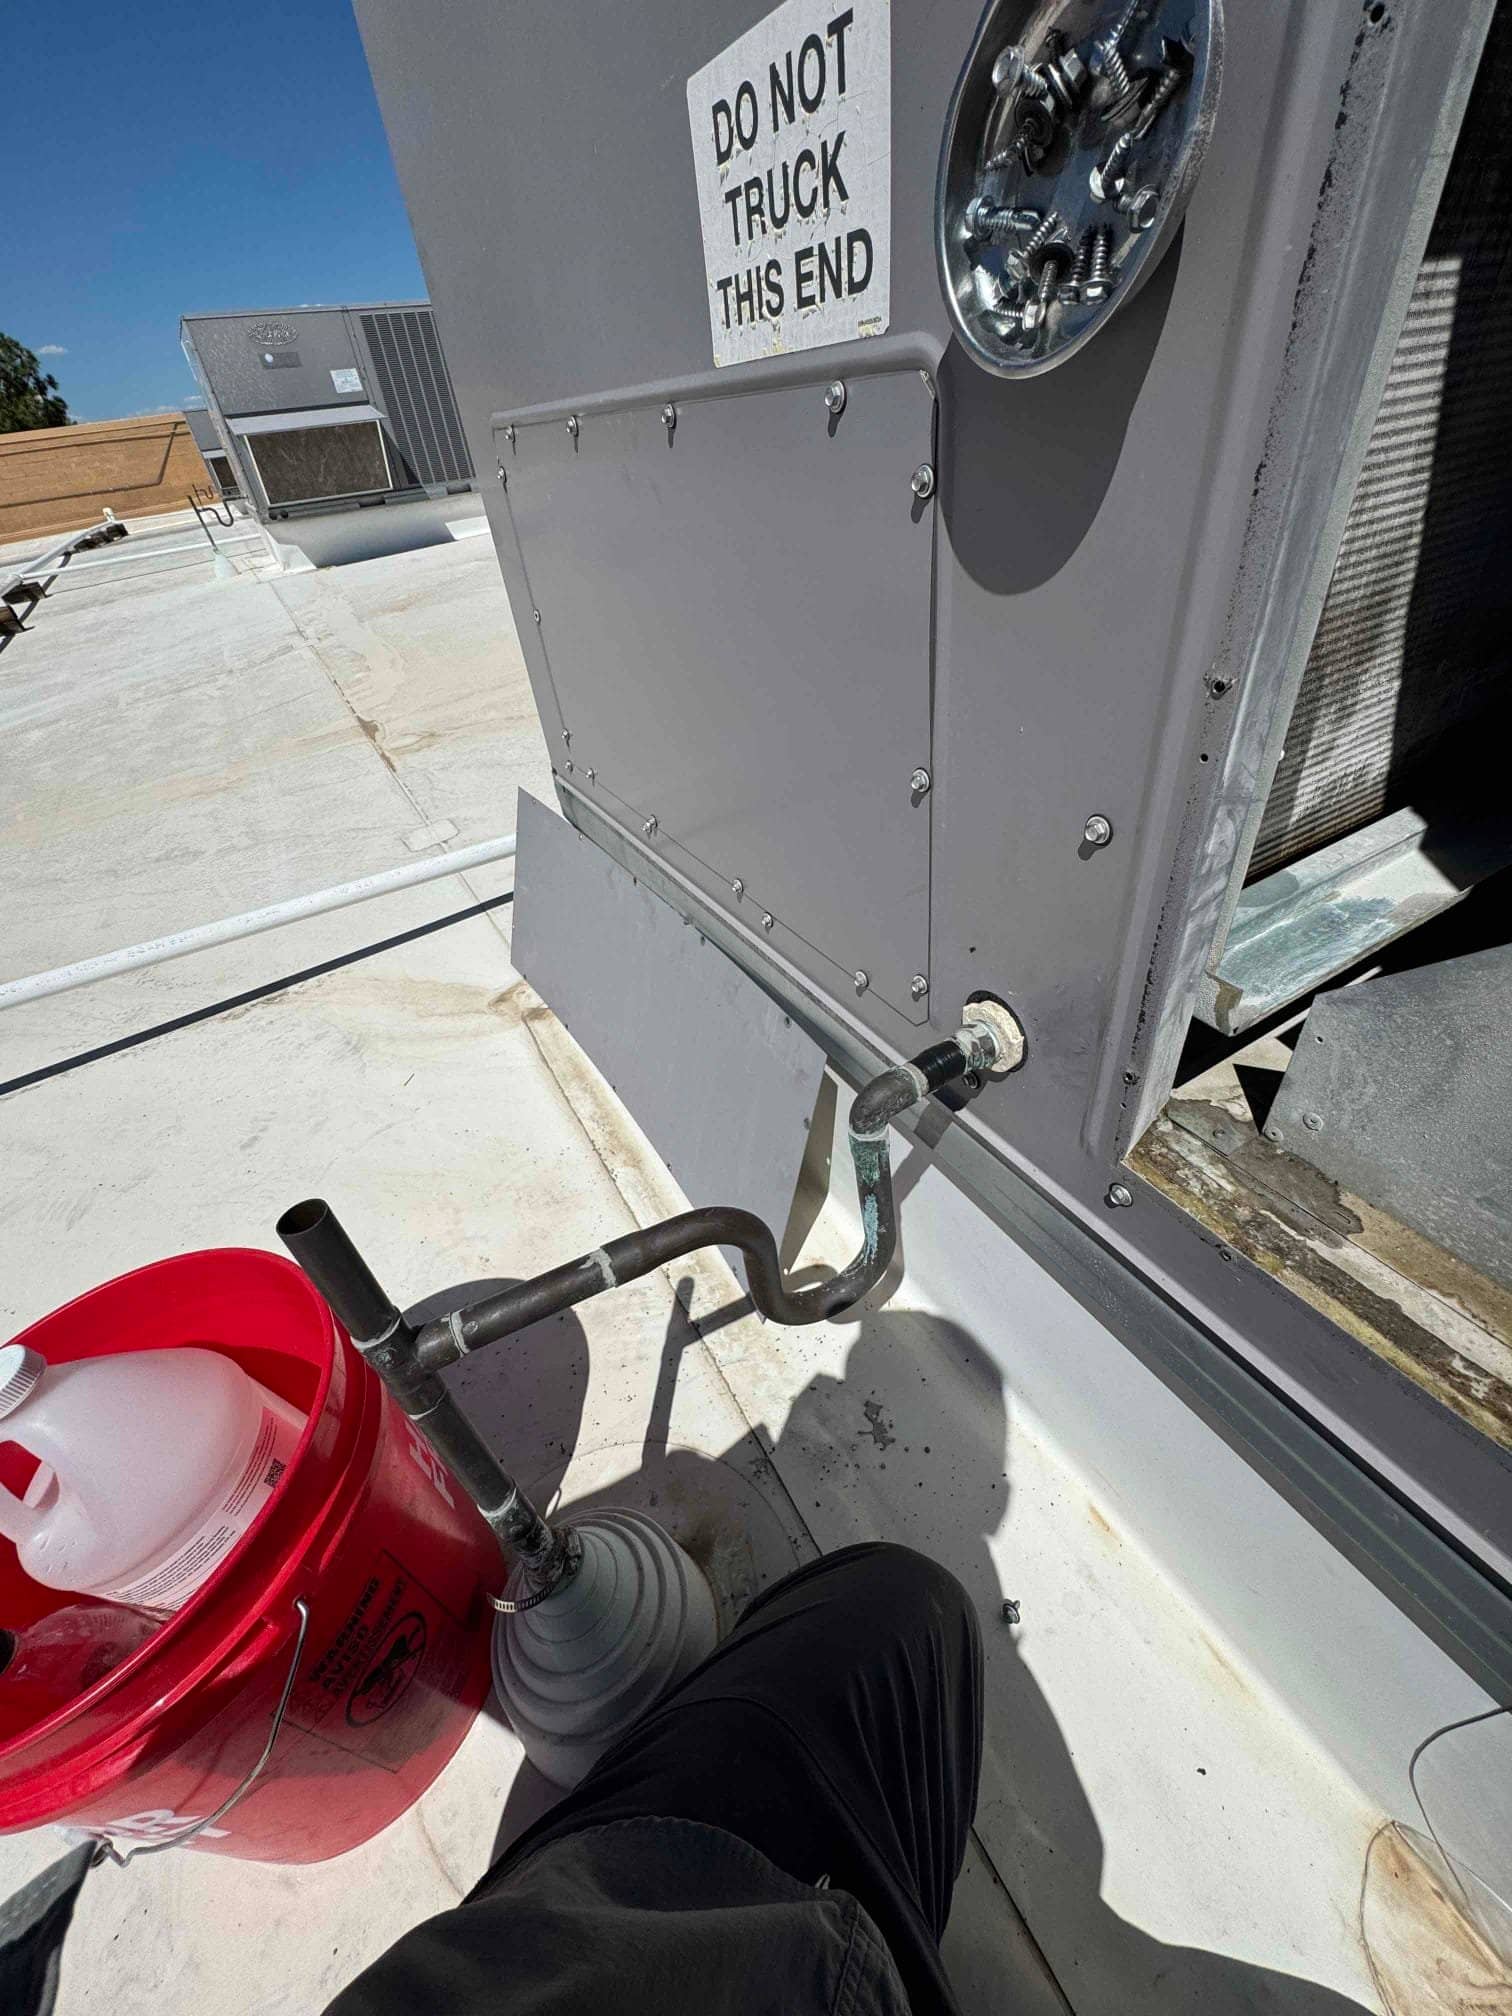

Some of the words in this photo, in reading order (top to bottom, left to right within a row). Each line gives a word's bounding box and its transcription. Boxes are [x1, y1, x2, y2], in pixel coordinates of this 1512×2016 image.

[711, 80, 758, 167] DO
[769, 7, 854, 134] NOT
[724, 130, 849, 246] TRUCK
[716, 258, 785, 330] THIS
[794, 227, 874, 310] END
[307, 1576, 380, 1681] WARNING
[321, 1624, 369, 1690] AVISO
